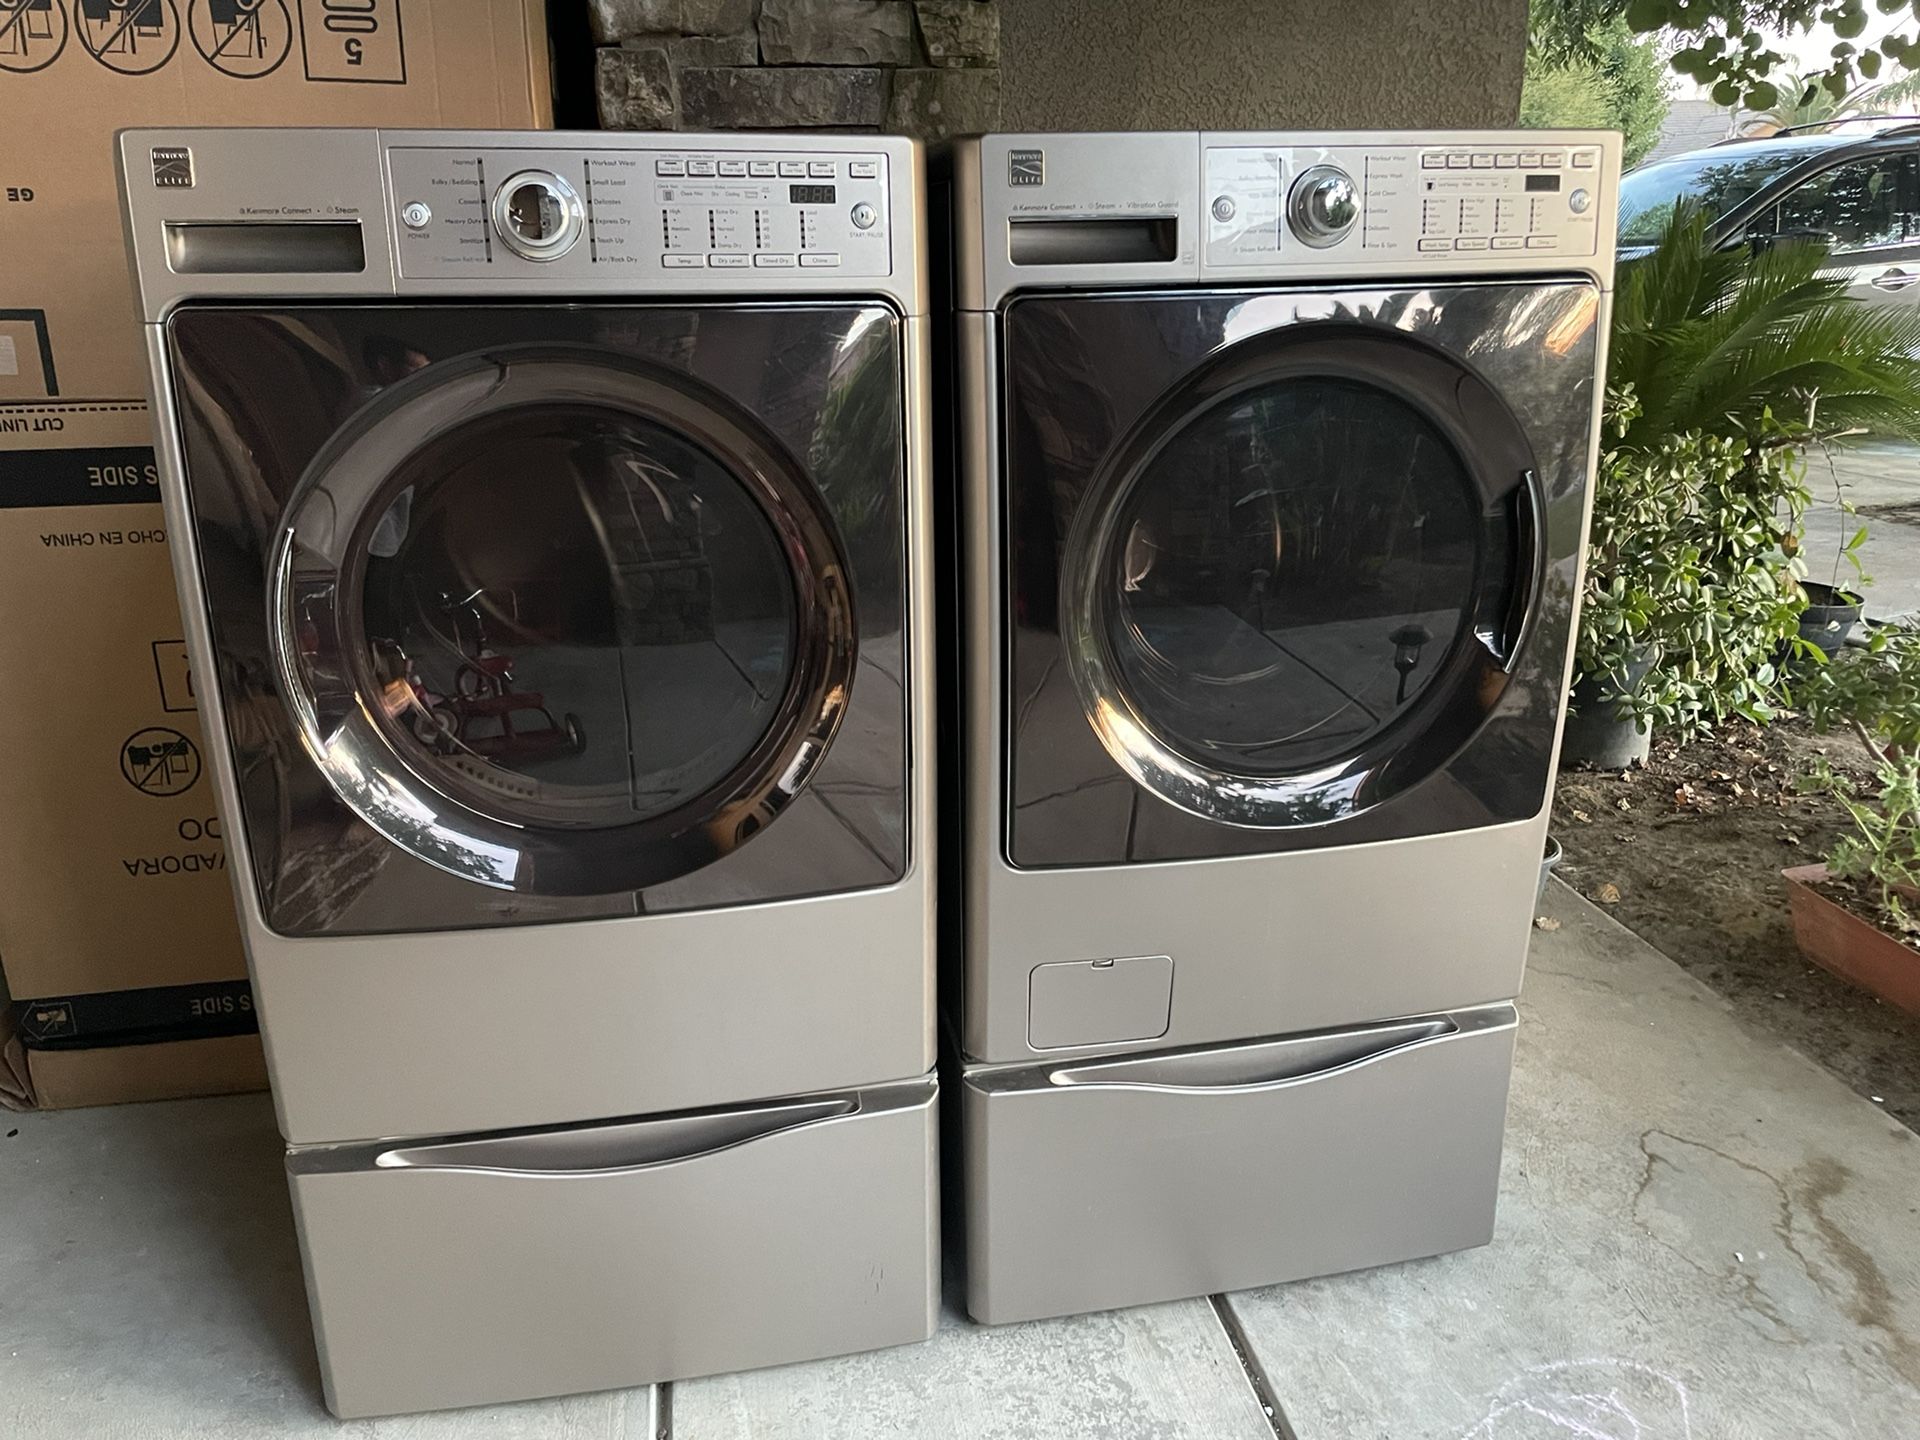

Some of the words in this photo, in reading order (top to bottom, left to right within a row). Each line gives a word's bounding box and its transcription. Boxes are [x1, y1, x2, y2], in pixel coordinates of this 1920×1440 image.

[344, 38, 362, 65] 5
[6, 187, 34, 202] GE
[0, 419, 28, 432] LIN
[33, 418, 64, 431] CUT
[87, 466, 138, 486] SIDE
[40, 532, 94, 547] CHINA
[100, 531, 123, 545] EN
[128, 530, 168, 544] CHO
[191, 997, 234, 1016] SIDE
